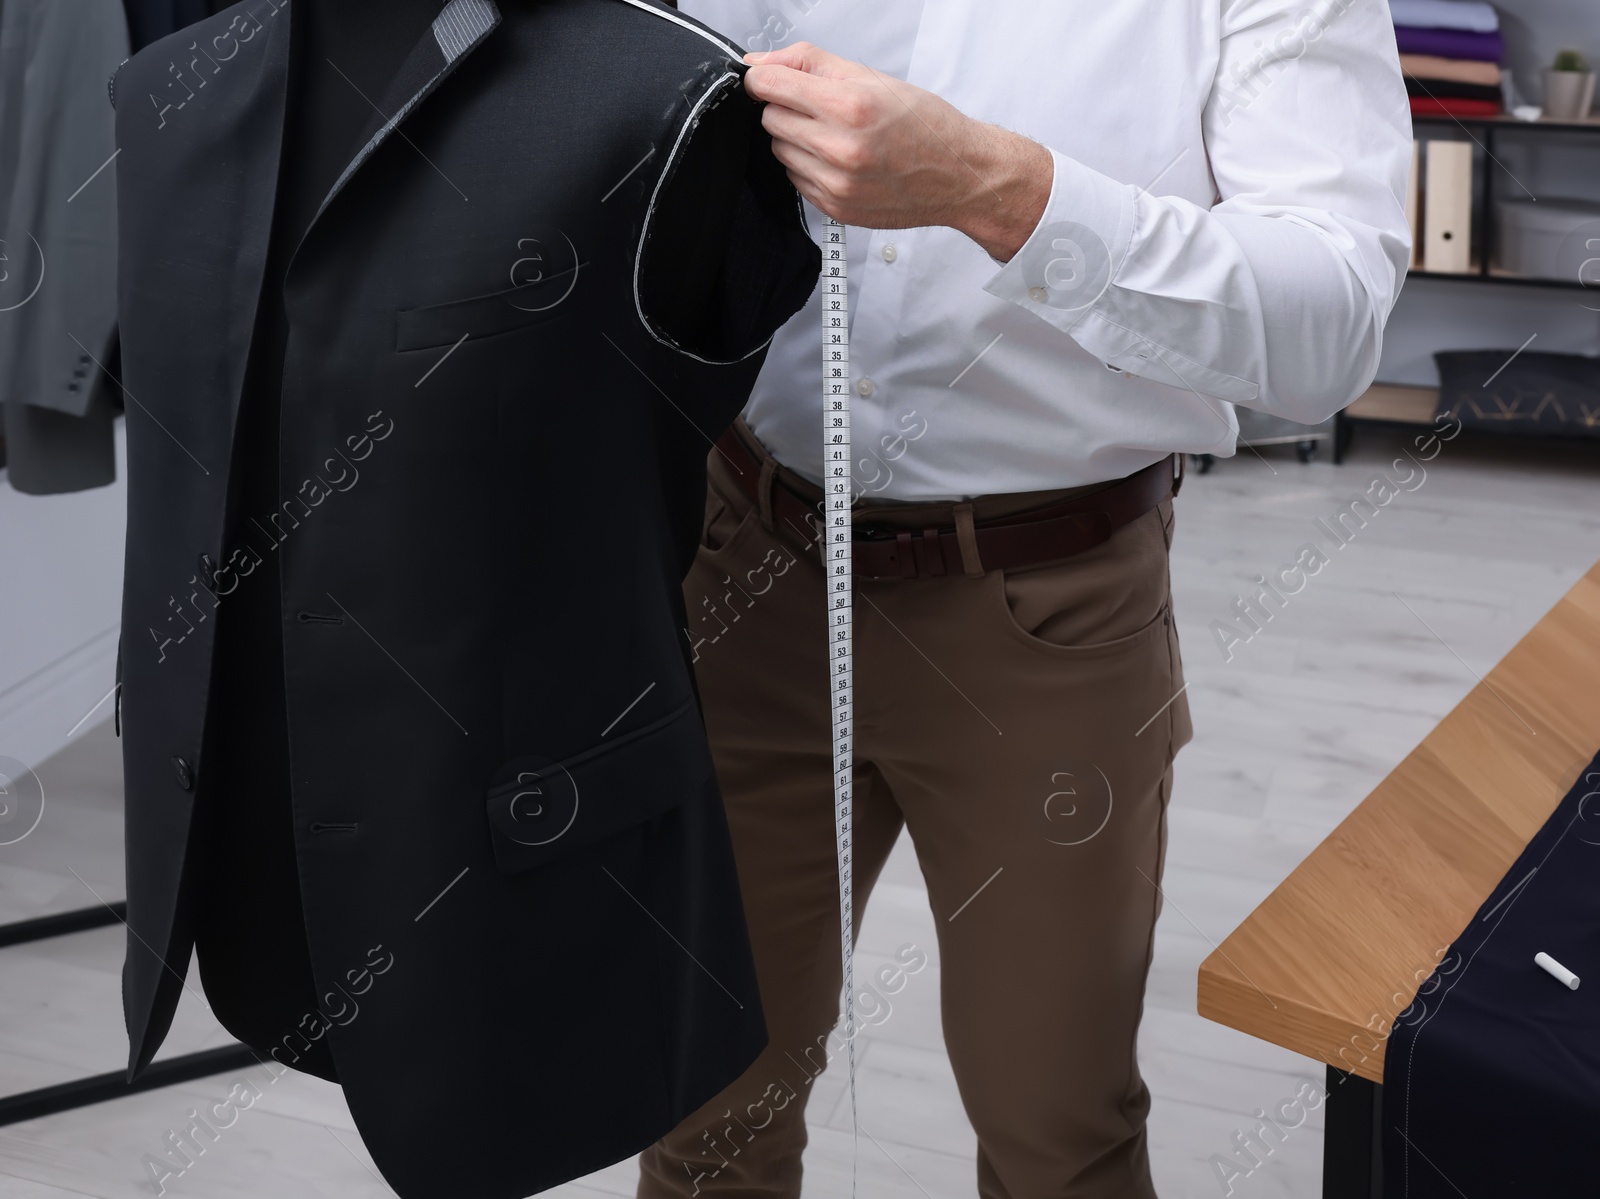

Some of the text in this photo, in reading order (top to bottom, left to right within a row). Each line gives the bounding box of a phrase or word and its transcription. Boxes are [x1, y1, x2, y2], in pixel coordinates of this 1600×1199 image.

[831, 233, 840, 242] 28
[831, 250, 840, 259] 29
[830, 267, 840, 276] 30
[831, 284, 839, 292] 31
[831, 301, 840, 309] 32
[831, 318, 841, 326] 33
[832, 335, 841, 343] 34
[832, 352, 841, 360] 35
[832, 368, 841, 377] 36
[832, 385, 842, 393] 37
[833, 402, 842, 410] 38
[833, 418, 842, 426] 39
[832, 435, 842, 443] 40
[833, 451, 842, 459] 41
[835, 517, 844, 525] 45
[835, 534, 844, 542] 46
[835, 550, 844, 558] 47
[836, 582, 845, 591] 49
[836, 599, 845, 607] 50
[837, 615, 845, 624] 51
[837, 631, 846, 640] 52
[838, 647, 846, 656] 53
[838, 663, 846, 672] 54
[838, 679, 847, 688] 55
[839, 695, 847, 704] 56
[840, 712, 847, 721] 57
[840, 728, 847, 737] 58
[840, 743, 847, 752] 59
[840, 759, 847, 768] 60
[841, 775, 847, 784] 61
